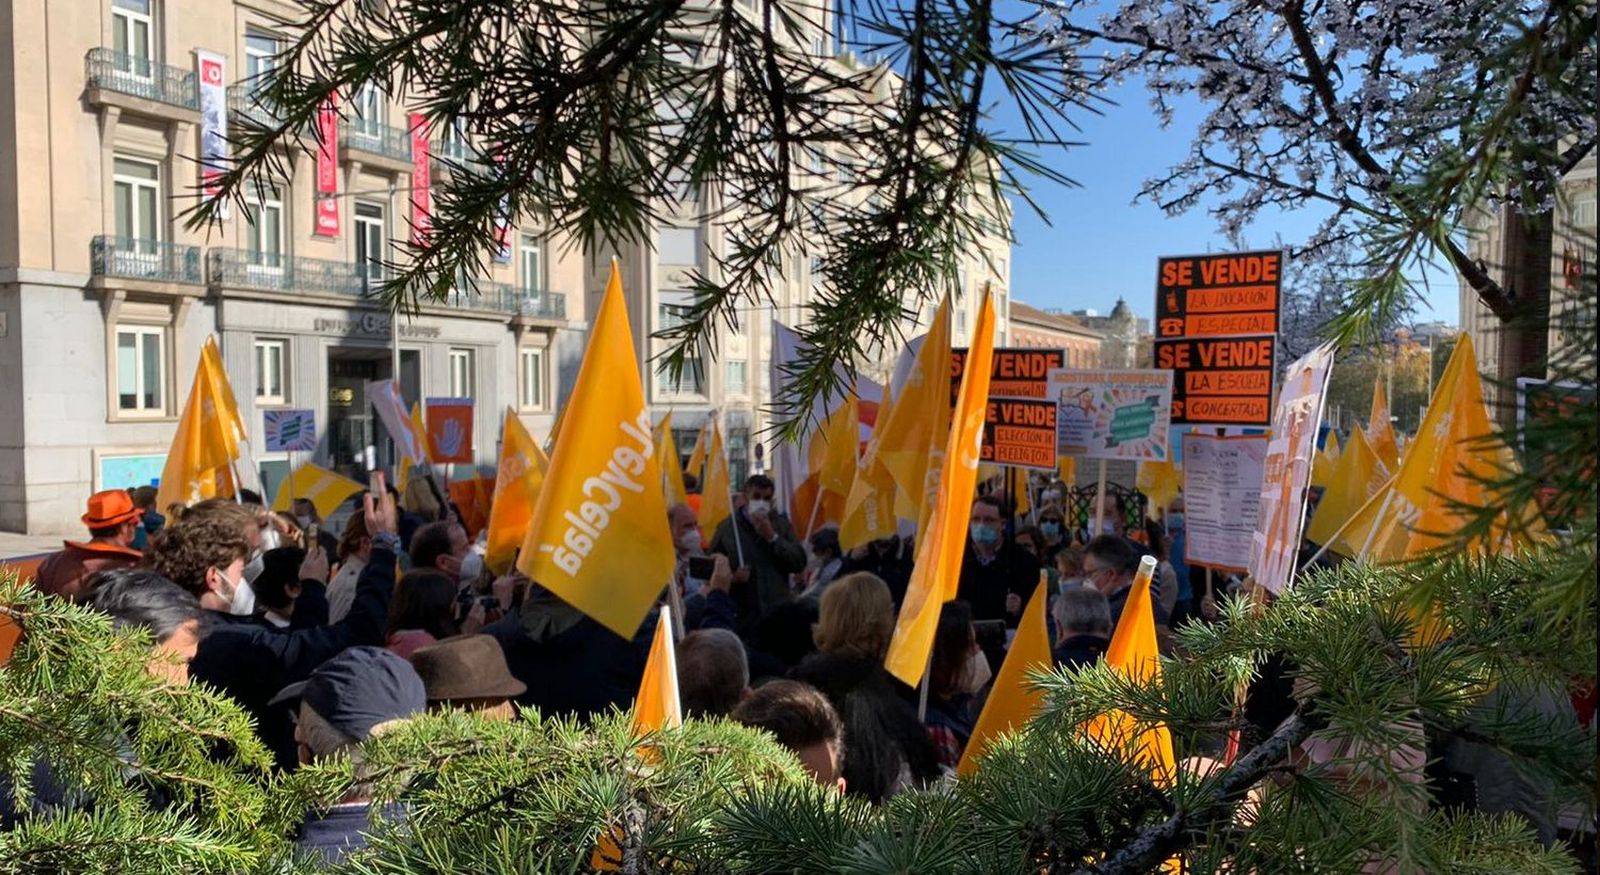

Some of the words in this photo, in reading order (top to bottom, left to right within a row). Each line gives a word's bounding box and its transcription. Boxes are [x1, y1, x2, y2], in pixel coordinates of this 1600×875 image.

[1161, 260, 1192, 287] SE
[1200, 255, 1278, 285] VENDE
[1158, 343, 1190, 368] SE
[1197, 340, 1272, 367] VENDE
[1191, 375, 1210, 391] LA
[1001, 403, 1056, 427] VENDE
[1192, 401, 1265, 417] CONCERTADA
